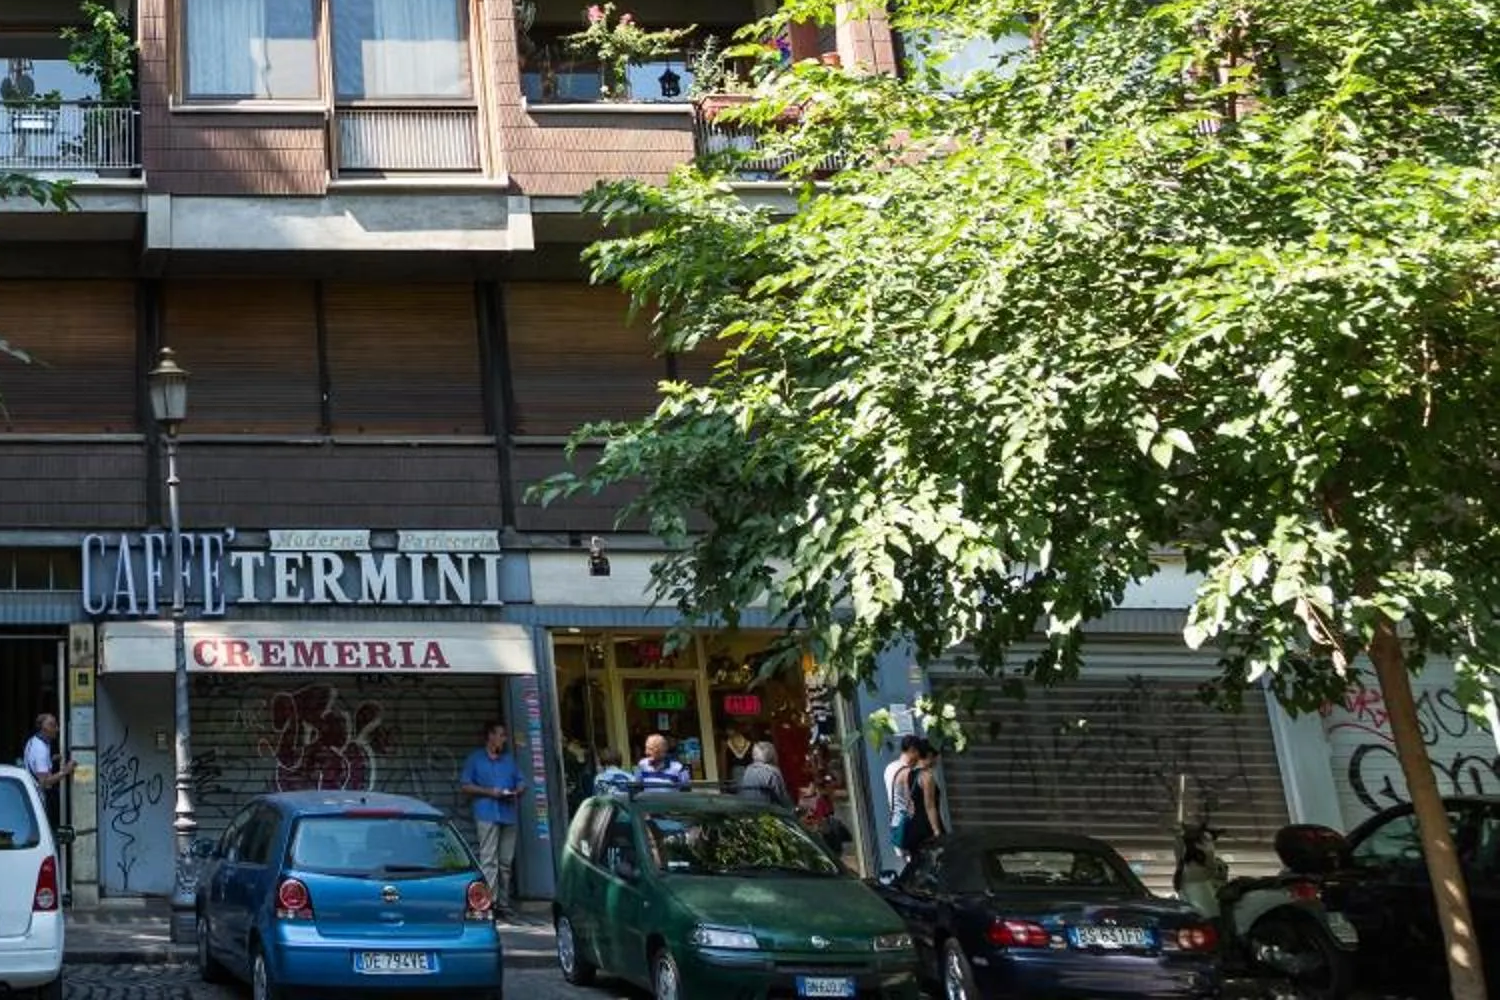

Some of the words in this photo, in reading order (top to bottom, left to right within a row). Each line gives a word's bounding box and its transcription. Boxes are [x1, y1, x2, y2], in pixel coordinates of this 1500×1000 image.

[230, 551, 503, 605] TERMINI
[192, 638, 451, 669] CREMERIA
[639, 690, 685, 708] SALDI
